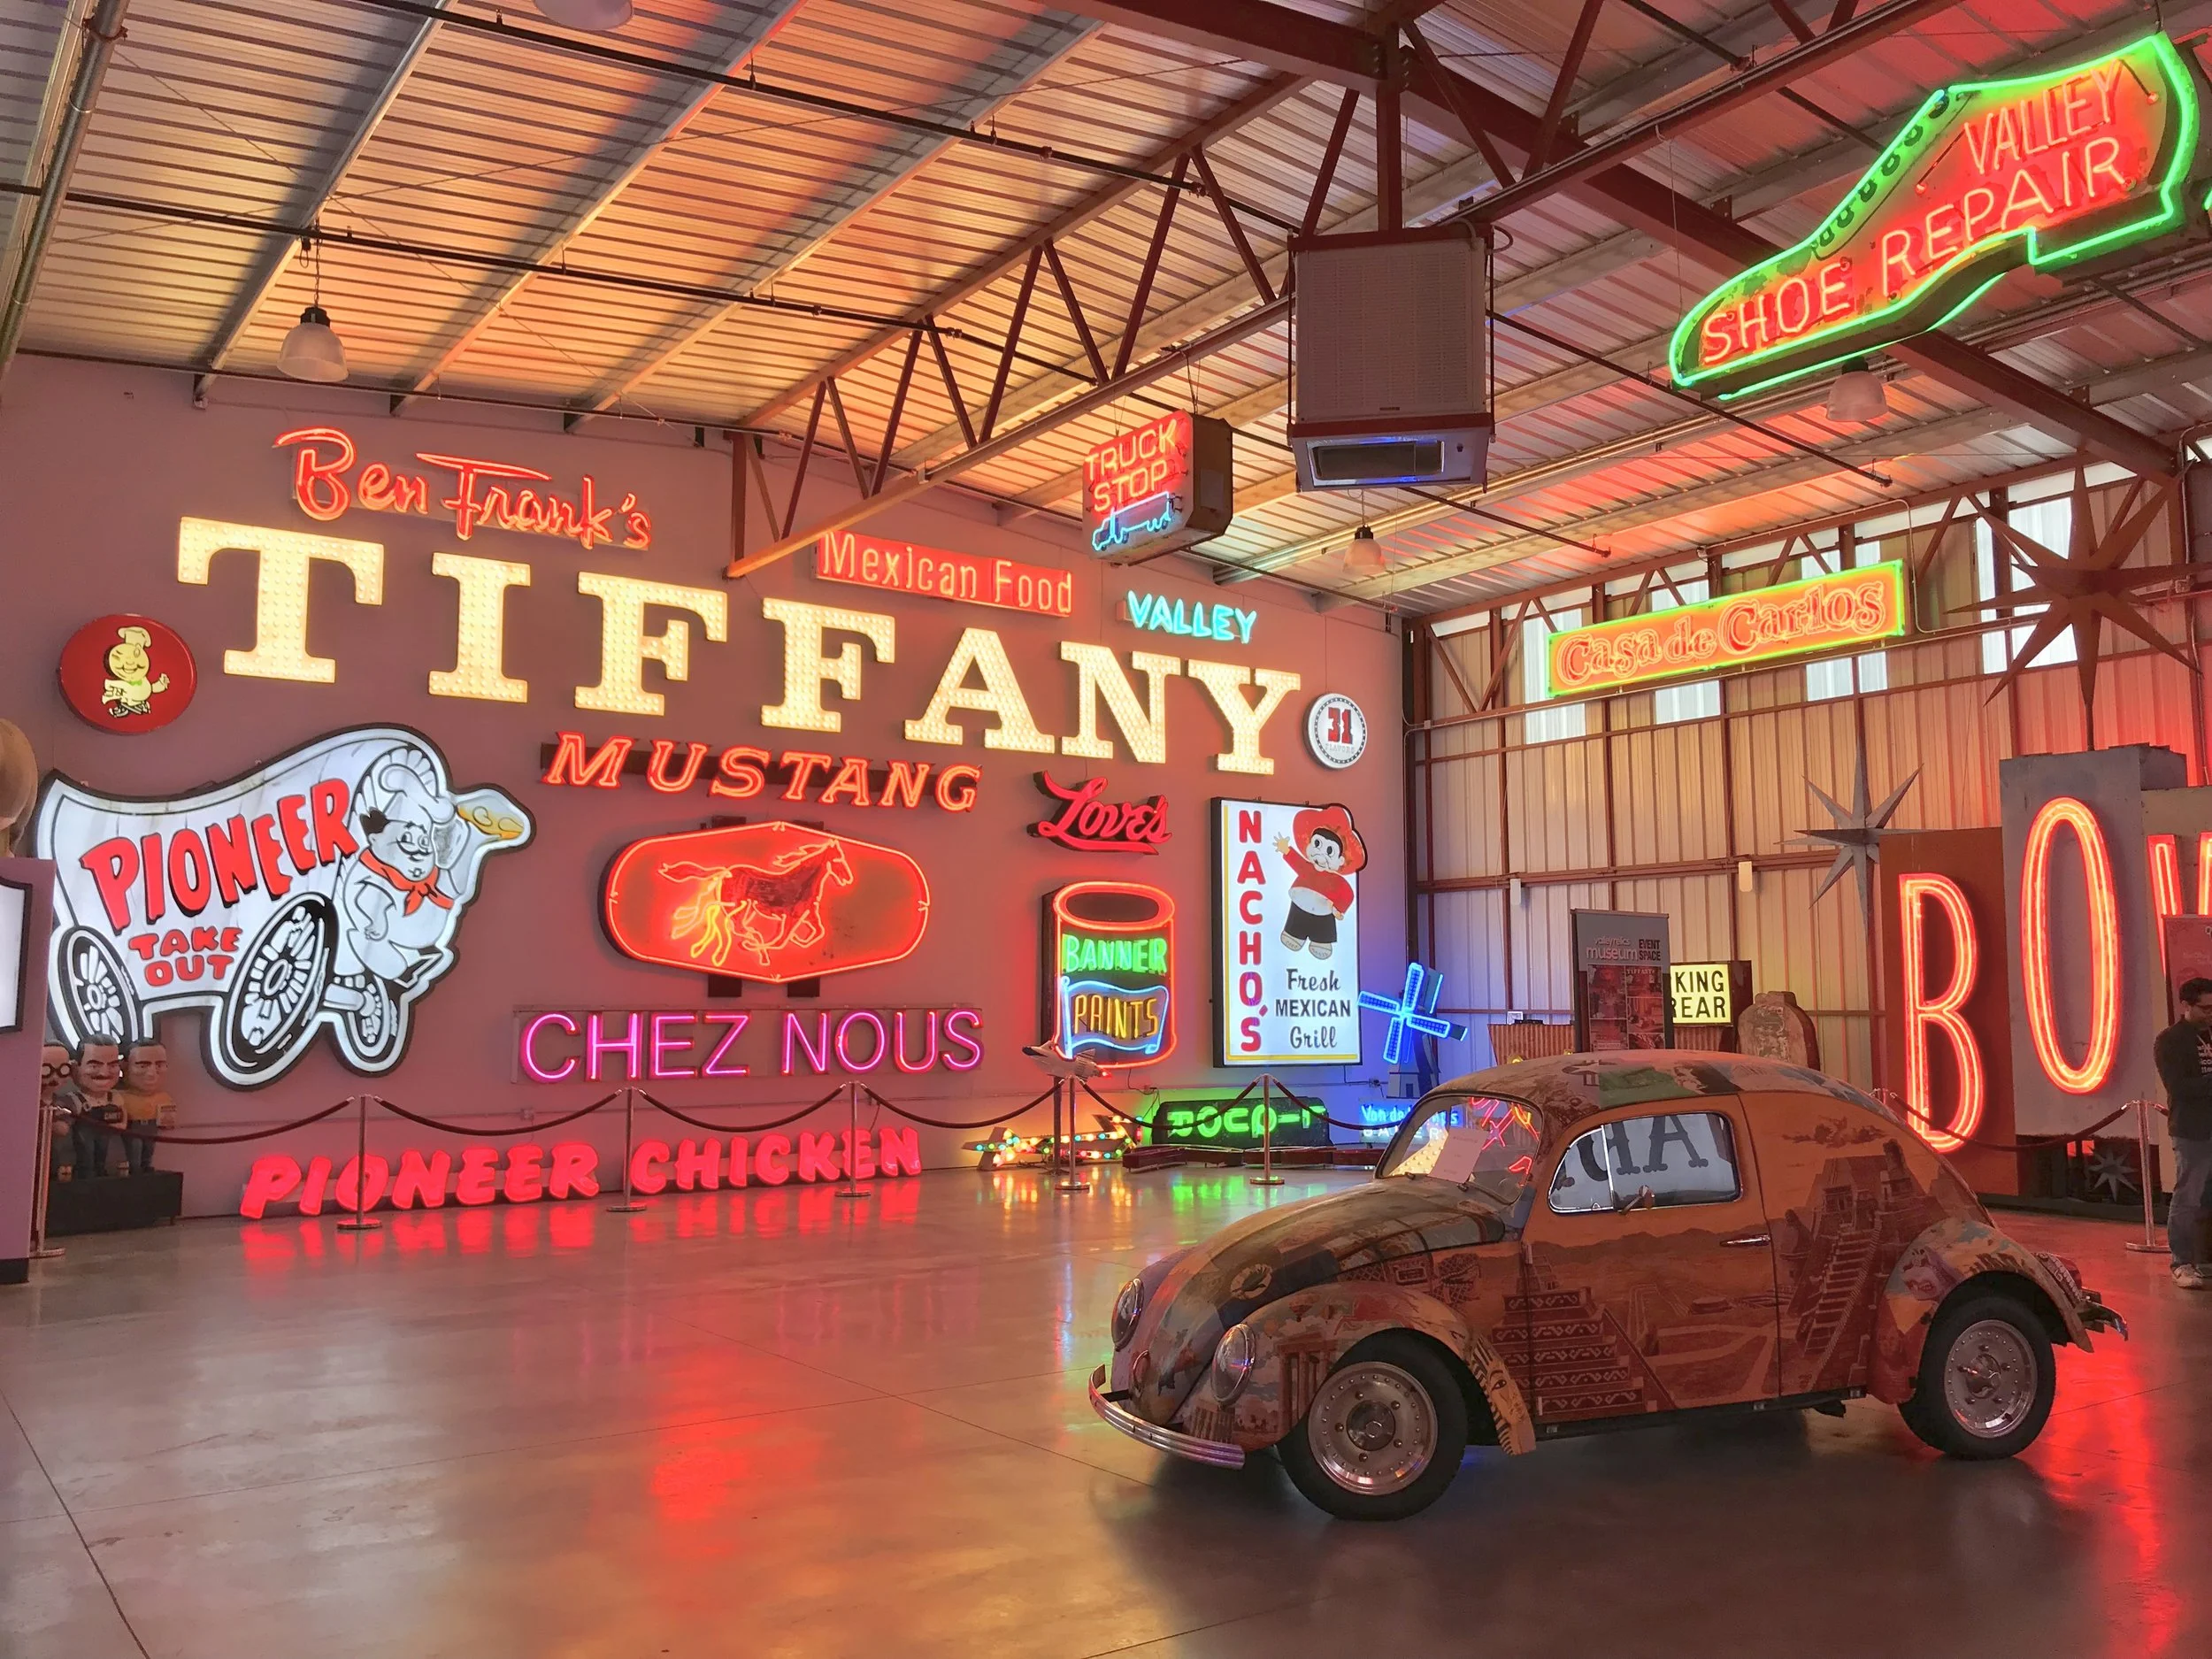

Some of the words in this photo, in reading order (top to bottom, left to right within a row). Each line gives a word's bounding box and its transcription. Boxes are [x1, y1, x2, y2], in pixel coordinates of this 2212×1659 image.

[1964, 59, 2124, 174] VALLEY
[1702, 263, 1851, 365] SHOE
[1881, 137, 2126, 297] REPAIR
[1085, 419, 1177, 480] TRUCK
[273, 427, 430, 521] Ben
[414, 451, 653, 549] Frank's
[1094, 459, 1167, 512] STOP
[822, 531, 977, 600] Mexican
[995, 559, 1073, 614] Food
[1127, 590, 1257, 644] VALLEY
[1557, 627, 1663, 685] Casa
[1663, 617, 1717, 663] de
[1718, 580, 1886, 656] Carlos
[178, 516, 1302, 776] TIFFANY
[1327, 707, 1353, 744] 31
[541, 731, 982, 812] MUSTANG
[79, 777, 360, 936] PIONEER
[128, 926, 243, 961] TAKE
[1063, 933, 1168, 973] BANNER
[1586, 947, 1638, 961] museum
[1639, 939, 1661, 949] EVENT
[1639, 950, 1662, 962] SPACE
[144, 955, 234, 987] OUT
[1286, 968, 1340, 992] Fresh
[1672, 970, 1724, 993] KING
[1074, 995, 1159, 1040] PAINTS
[1275, 999, 1351, 1018] MEXICAN
[520, 1012, 750, 1083] CHEZ
[780, 1008, 985, 1076] NOUS
[1289, 1025, 1338, 1049] Grill
[240, 1142, 601, 1219] PIONEER
[630, 1125, 922, 1195] CHICKEN
